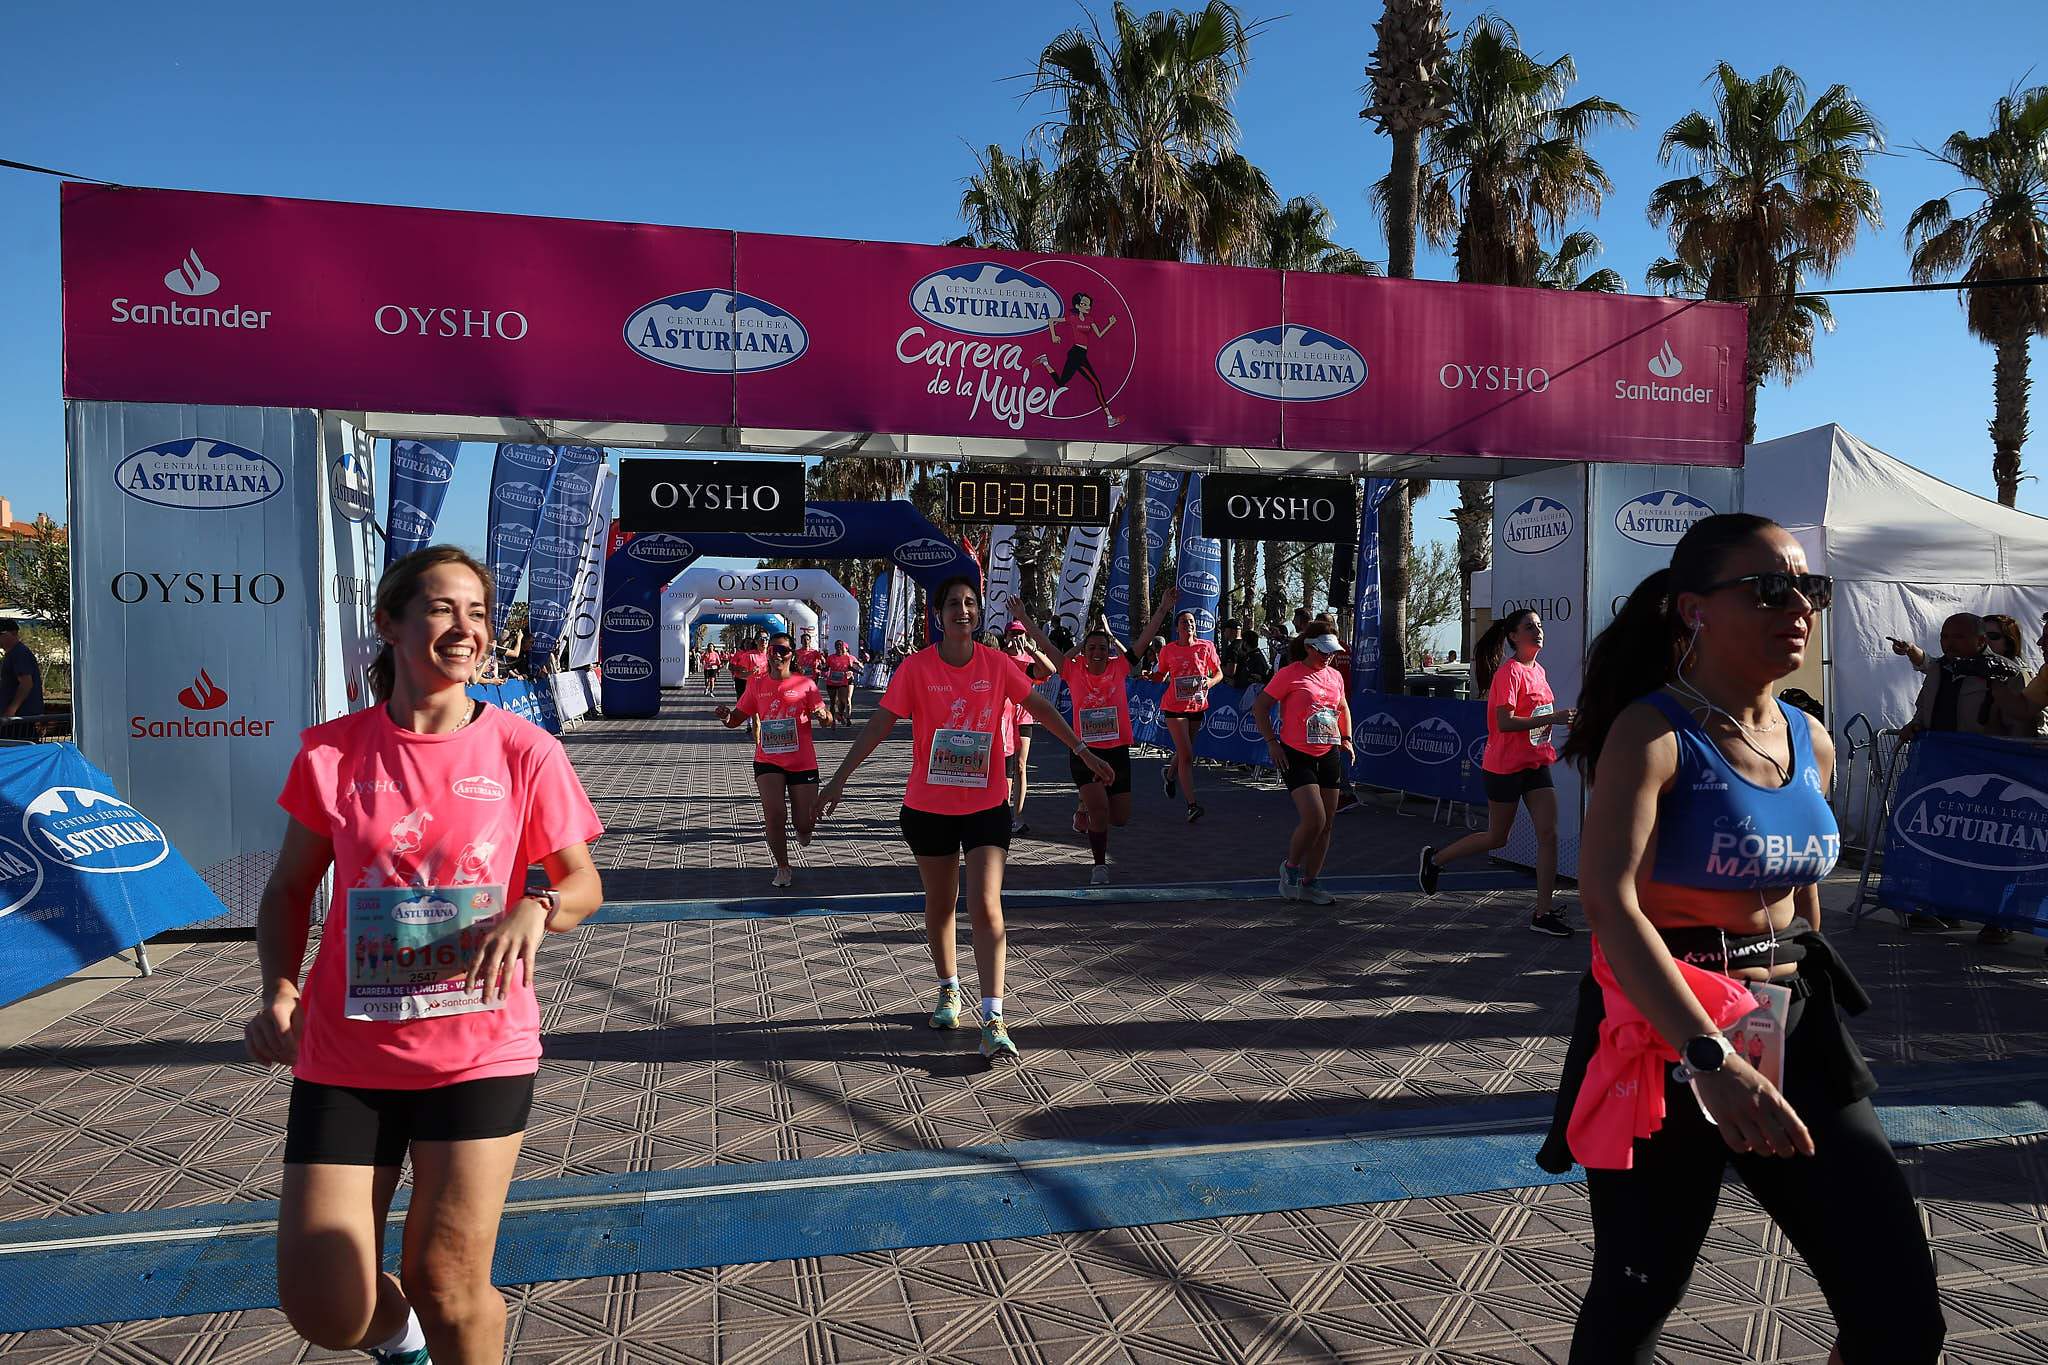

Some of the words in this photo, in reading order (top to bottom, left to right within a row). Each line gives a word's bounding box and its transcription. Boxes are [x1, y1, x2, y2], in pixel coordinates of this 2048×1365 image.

[946, 285, 995, 296] CENTRAL
[111, 297, 272, 329] Santander
[922, 285, 1050, 320] ASTURIANA
[374, 304, 528, 341] OYSHO
[667, 316, 724, 328] CENTRAL
[638, 315, 794, 354] ASTURIANA
[896, 326, 1022, 371] Carrera
[1228, 348, 1357, 384] ASTURIANA
[1439, 363, 1550, 393] OYSHO
[926, 368, 952, 395] de
[955, 369, 973, 397] la
[968, 368, 1070, 431] Mujer
[1615, 381, 1714, 404] Santander
[154, 461, 201, 470] CENTRAL
[128, 462, 272, 493] ASTURIANA
[650, 482, 780, 511] OYSHO
[959, 481, 1098, 517] 00:39:07
[1226, 494, 1335, 522] OYSHO
[1507, 520, 1568, 542] ASTURIANA
[632, 544, 688, 557] ASTURIANA
[899, 549, 953, 561] ASTURIANA
[111, 571, 285, 605] OYSHO
[333, 573, 371, 606] OYSHO
[718, 574, 799, 592] OYSHO
[605, 615, 650, 627] ASTURIANA
[605, 664, 649, 675] ASTURIANA
[131, 715, 275, 738] Santander
[1357, 728, 1398, 747] ASTURIANA
[1409, 731, 1455, 754] ASTURIANA
[1692, 782, 1729, 791] VIATOR
[52, 812, 99, 830] CENTRAL
[1938, 800, 1996, 816] CENTRAL
[2002, 807, 2048, 823] LECHE
[1905, 800, 2048, 853] ASTURIAN
[40, 821, 162, 862] ASTURIANA
[394, 907, 454, 919] ASTURIANA
[396, 945, 456, 967] 016
[356, 986, 392, 996] CARRERA
[394, 986, 405, 995] DE
[419, 981, 449, 994] MUJER
[409, 971, 438, 983] 2547
[364, 1001, 411, 1013] OYSHO
